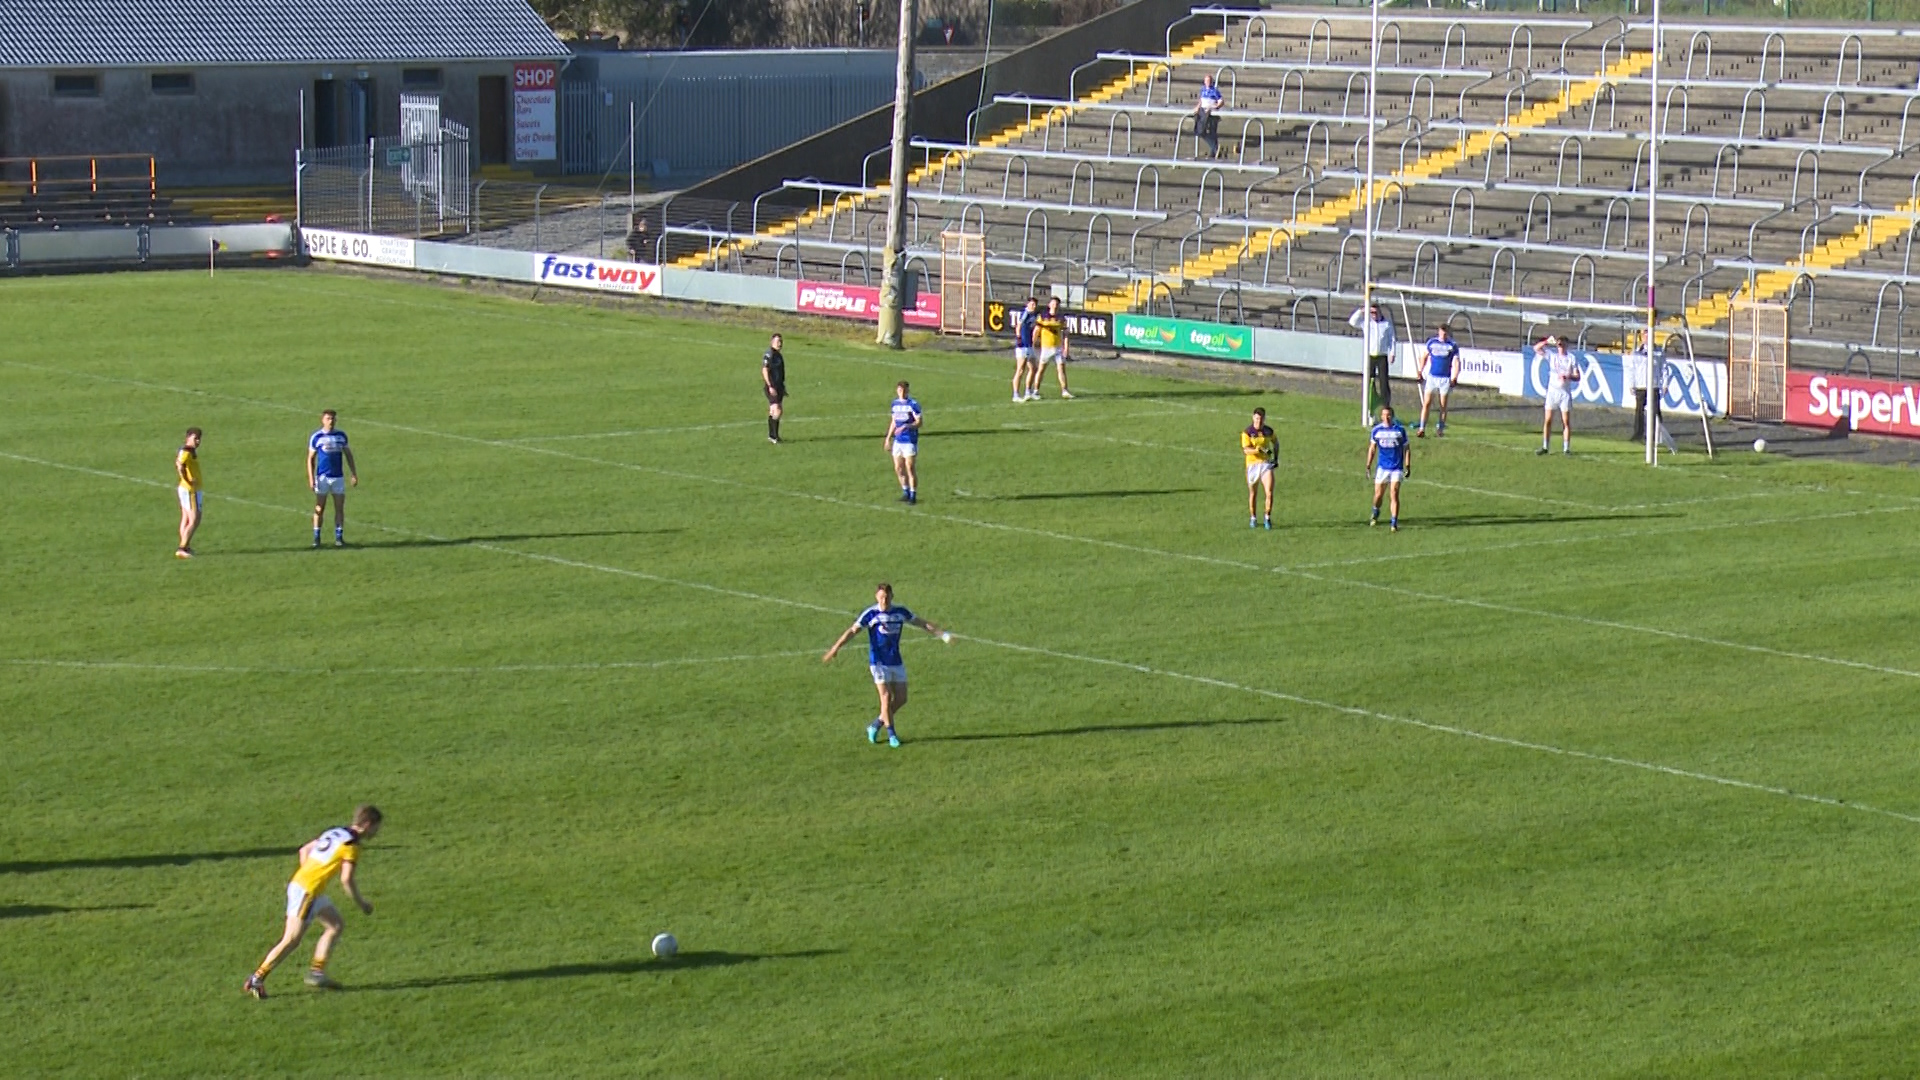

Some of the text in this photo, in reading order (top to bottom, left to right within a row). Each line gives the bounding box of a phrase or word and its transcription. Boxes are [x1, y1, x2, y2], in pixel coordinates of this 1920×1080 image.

[515, 69, 554, 86] SHOP
[341, 239, 349, 256] &
[352, 238, 373, 258] CO.
[541, 255, 656, 290] fastway
[799, 289, 867, 312] PEOPLE
[1080, 318, 1107, 336] BAR
[1460, 359, 1502, 374] lanbia
